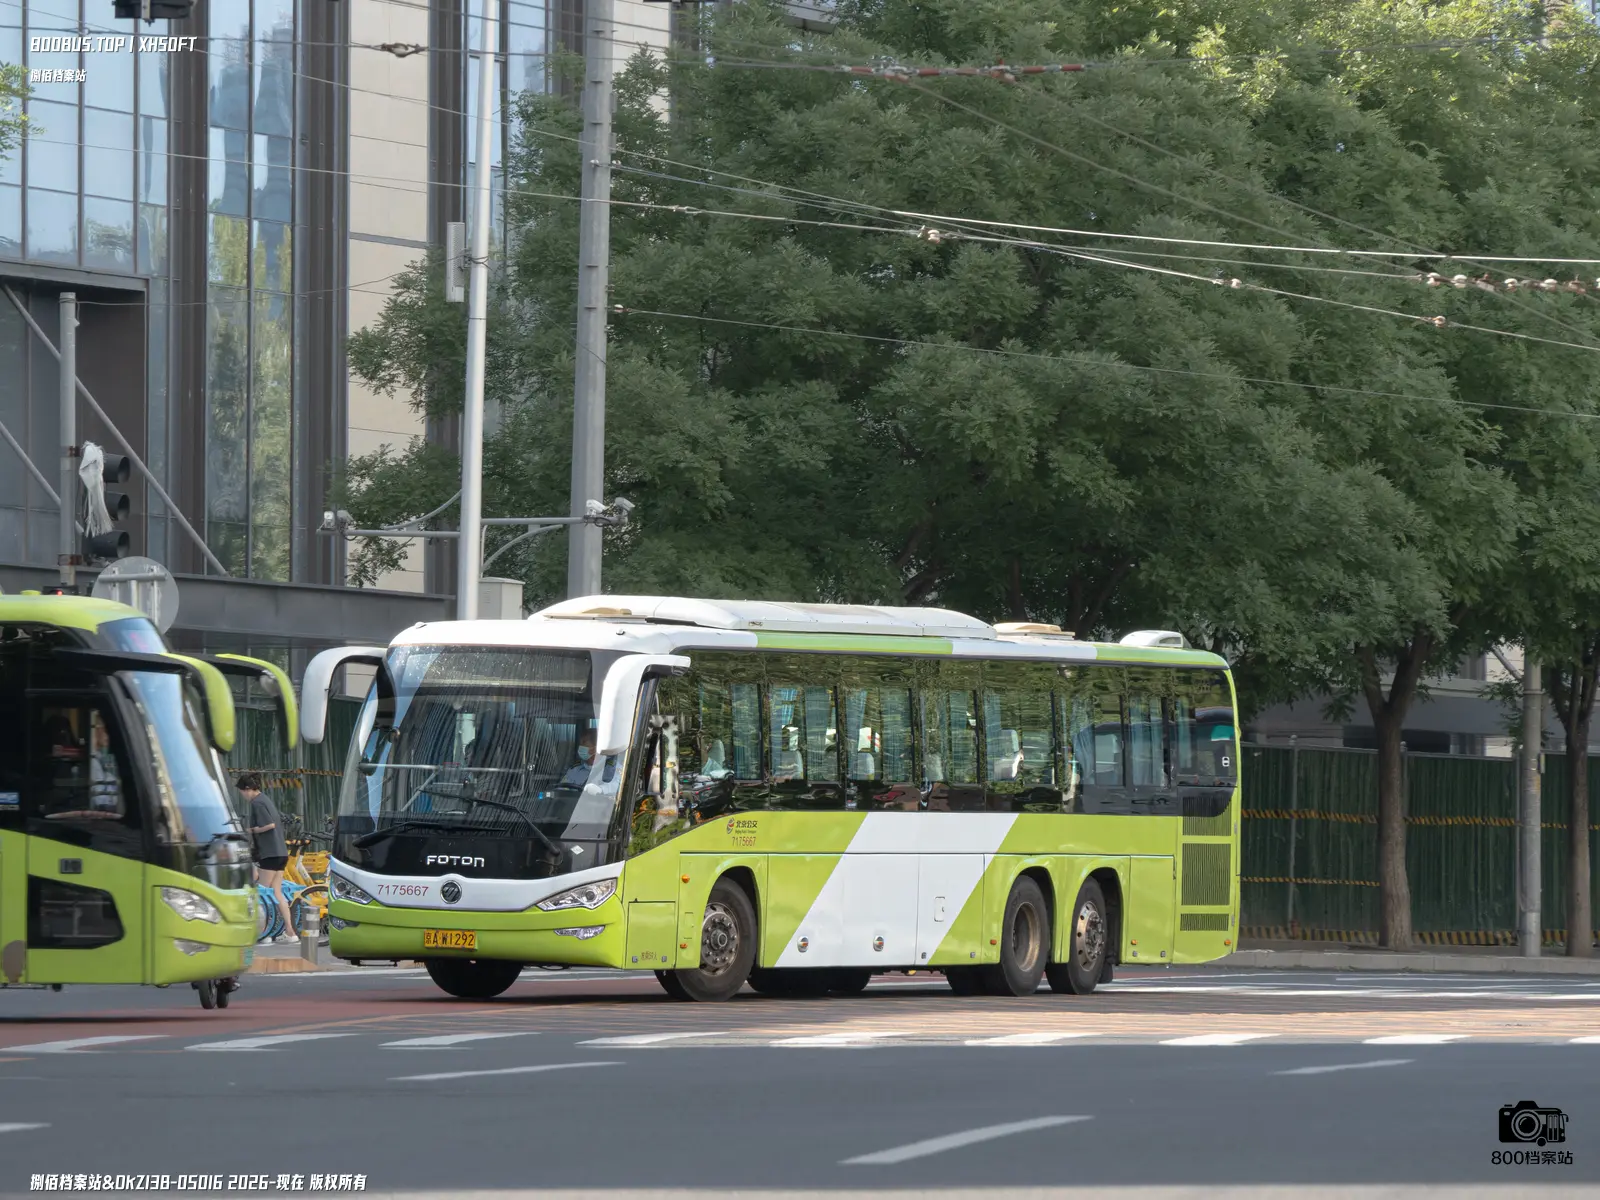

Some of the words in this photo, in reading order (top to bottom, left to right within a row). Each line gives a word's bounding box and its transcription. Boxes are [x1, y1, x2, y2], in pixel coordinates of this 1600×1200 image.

[732, 836, 756, 846] 7175667
[426, 855, 484, 867] FOTON
[378, 884, 429, 896] 7175667
